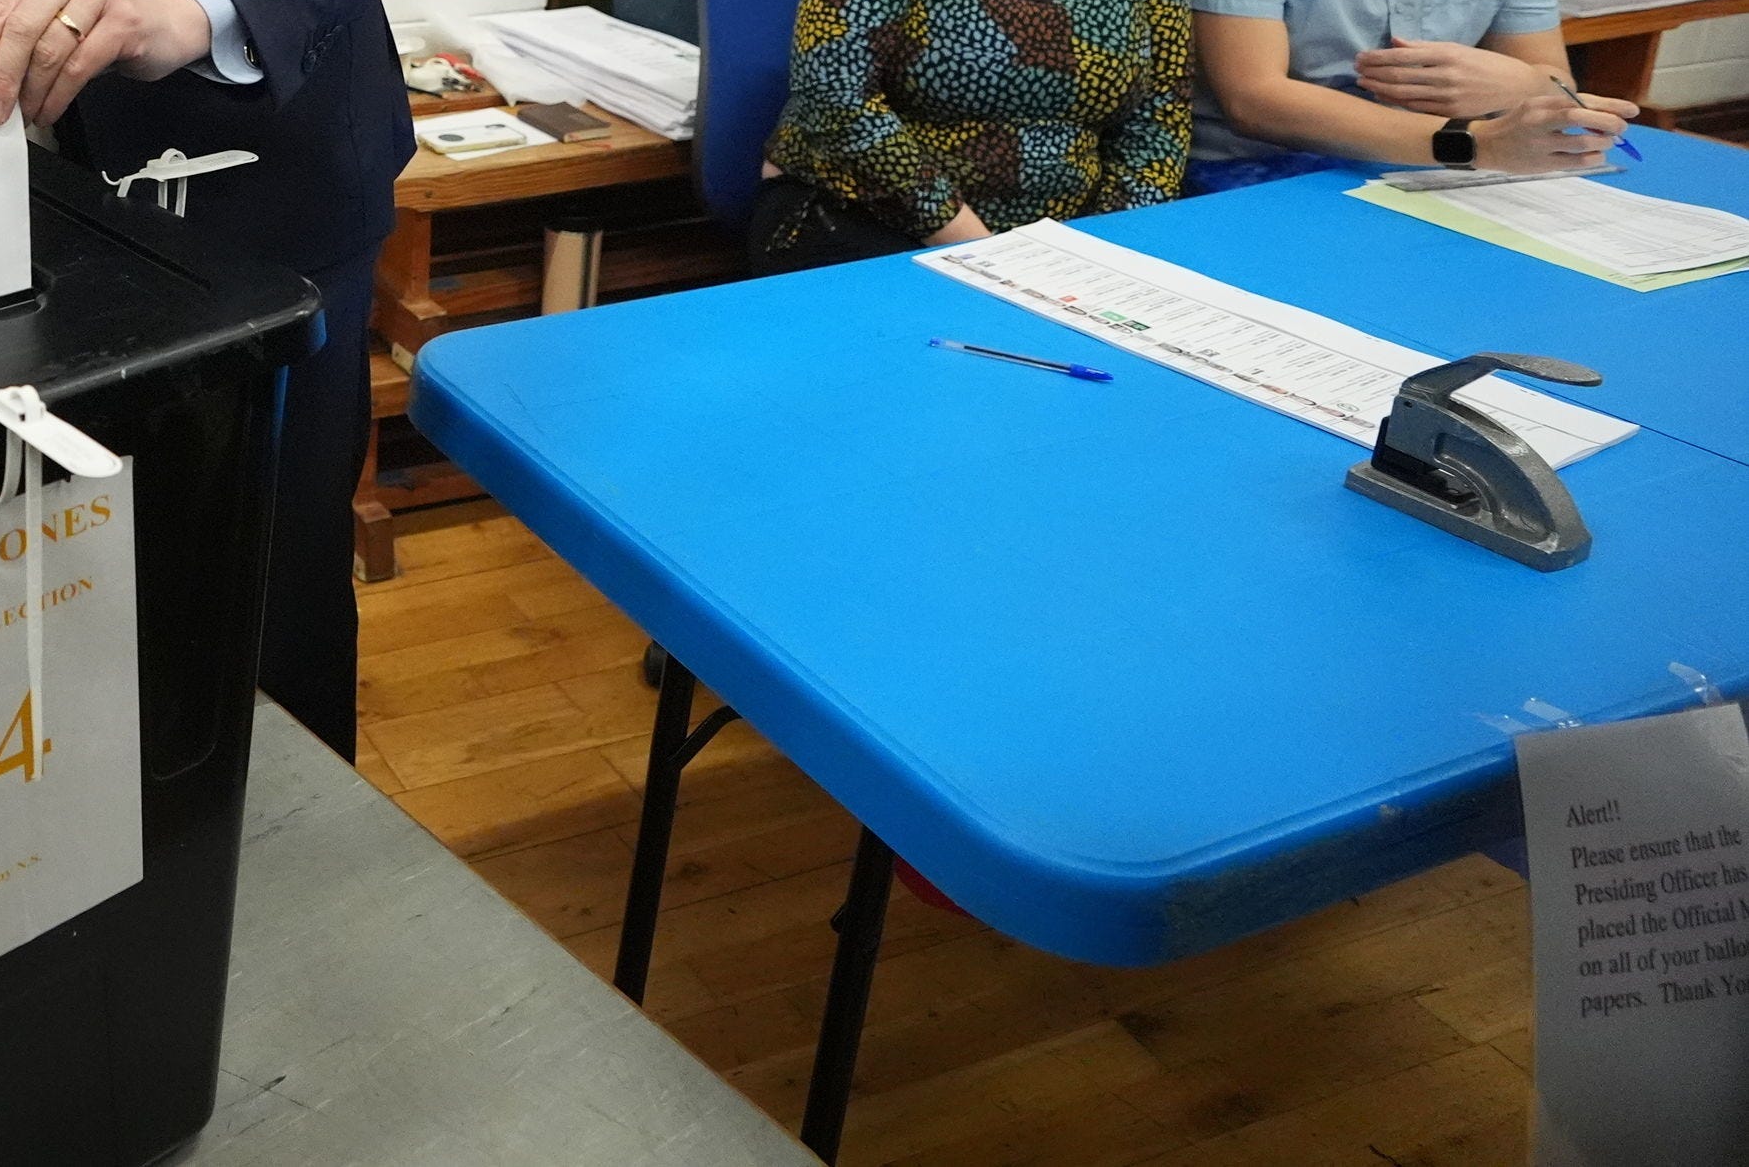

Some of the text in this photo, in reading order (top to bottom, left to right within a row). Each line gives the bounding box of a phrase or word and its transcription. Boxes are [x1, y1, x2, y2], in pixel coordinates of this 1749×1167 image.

[1566, 799, 1621, 828] Alert!!
[1570, 825, 1743, 869] Please ensure that the
[1575, 864, 1749, 906] Presiding Officer has
[1577, 914, 1637, 948] placed
[1641, 912, 1668, 934] the
[1672, 901, 1737, 930] Official
[1579, 936, 1749, 977] on all of your ballo
[1580, 974, 1749, 1018] papers. Thank Yo
